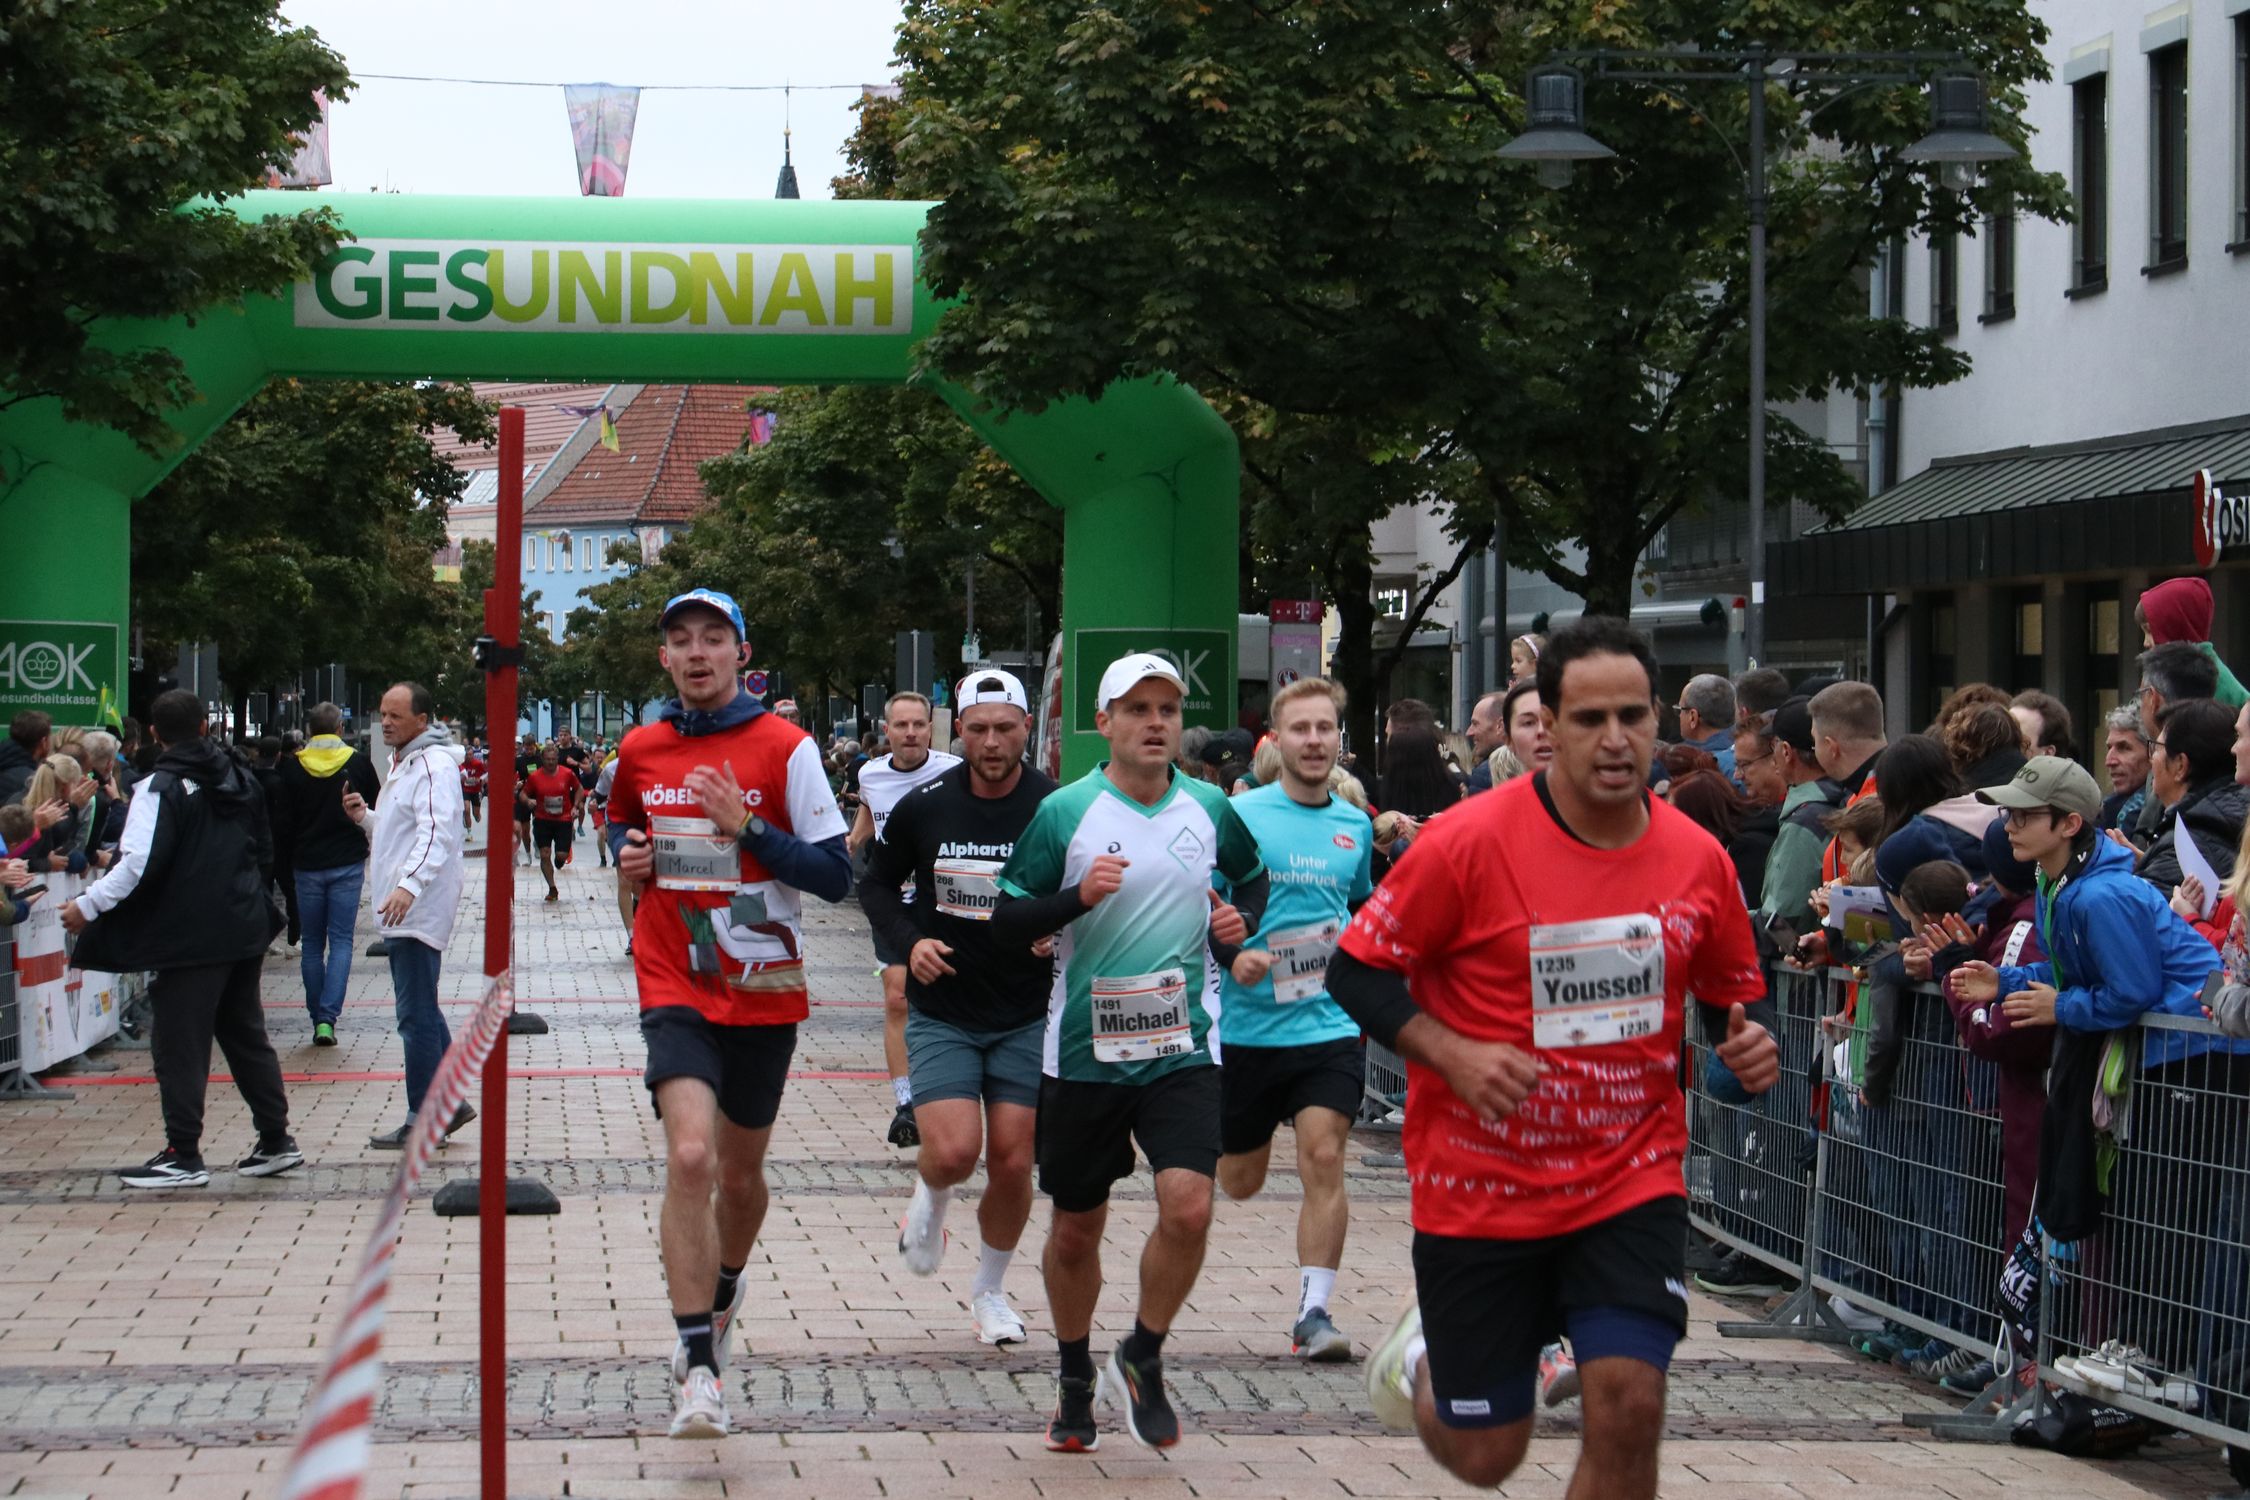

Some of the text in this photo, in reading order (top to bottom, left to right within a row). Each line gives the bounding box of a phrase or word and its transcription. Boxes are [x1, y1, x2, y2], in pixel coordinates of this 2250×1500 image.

[315, 246, 893, 328] GESUNDNAH
[0, 693, 99, 706] esundheitskasse.
[654, 838, 676, 851] 1189
[938, 842, 1014, 859] Alpharti
[668, 856, 714, 875] Marcel
[1289, 852, 1328, 870] Unter
[936, 875, 954, 886] 208
[1290, 955, 1327, 976] Luca
[1536, 956, 1576, 974] 1235
[1543, 966, 1652, 1004] Youssef
[1094, 999, 1121, 1011] 1491
[1100, 1006, 1179, 1032] Michael
[1619, 1020, 1650, 1038] 1235
[1155, 1043, 1182, 1057] 1491
